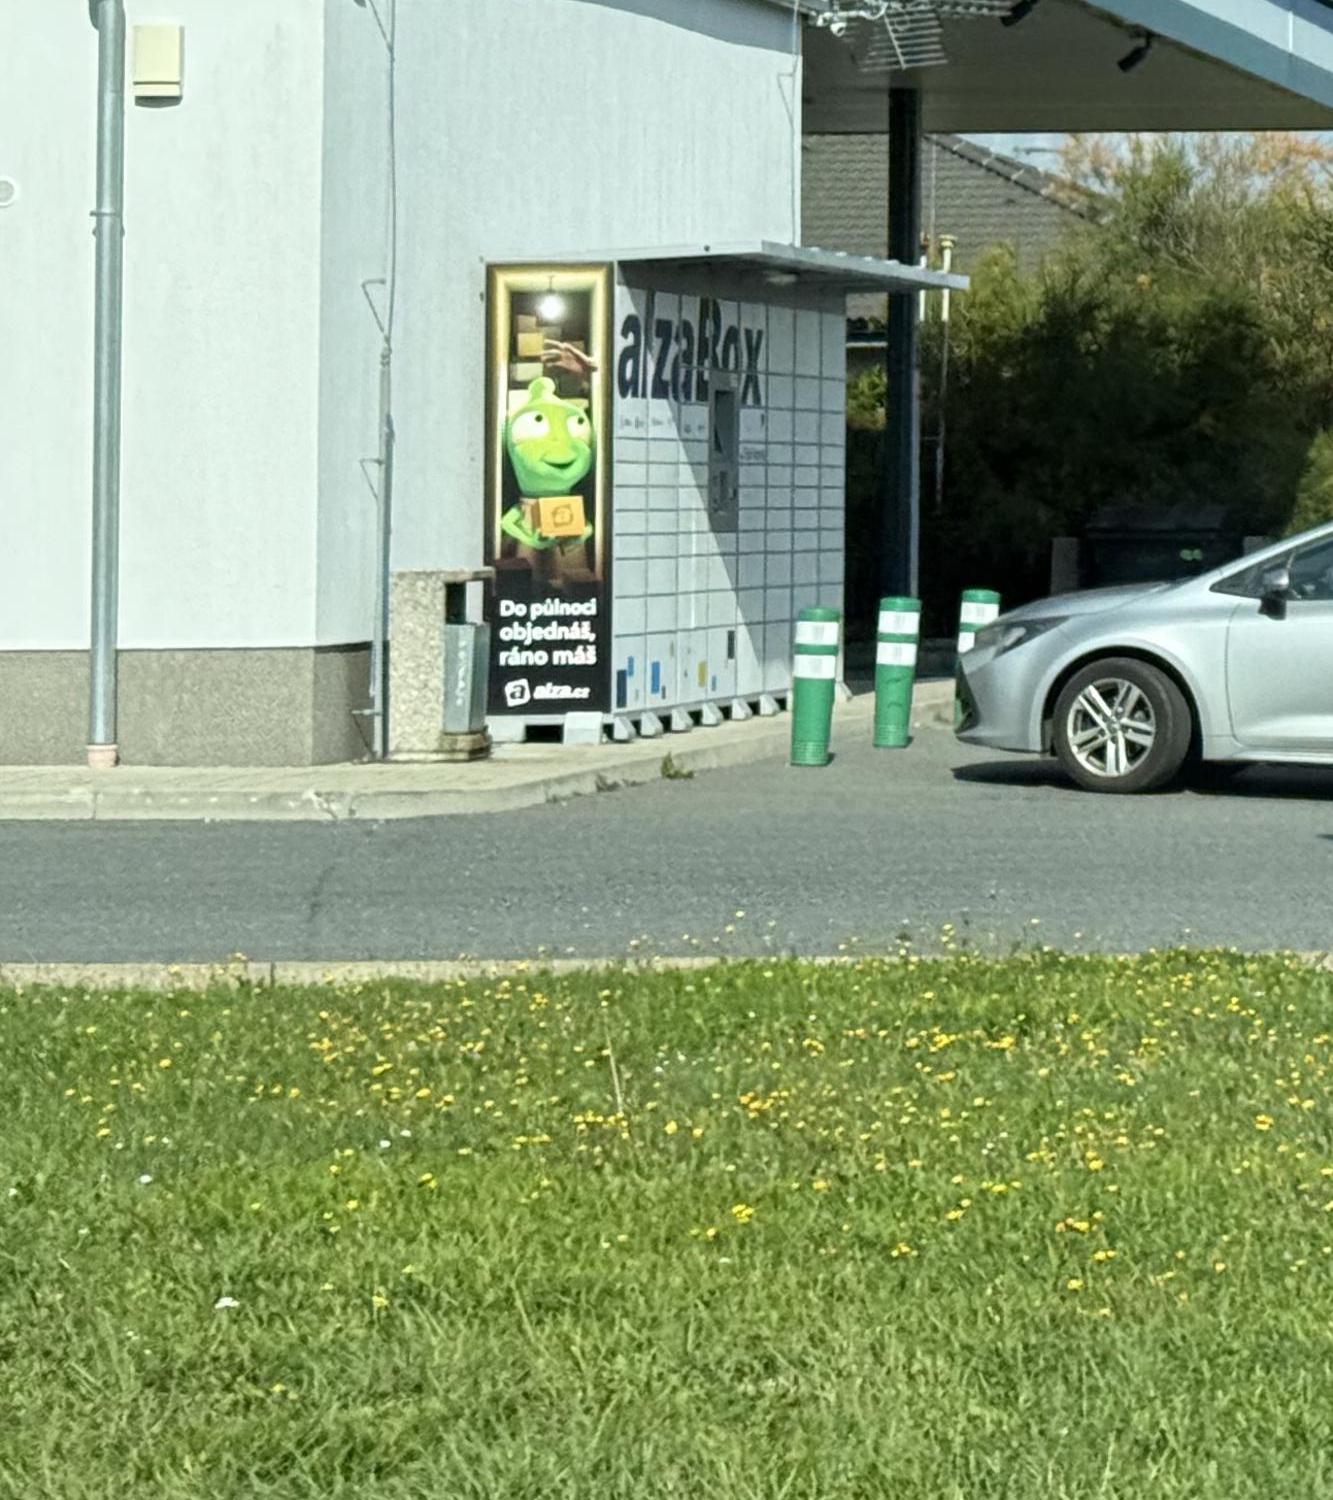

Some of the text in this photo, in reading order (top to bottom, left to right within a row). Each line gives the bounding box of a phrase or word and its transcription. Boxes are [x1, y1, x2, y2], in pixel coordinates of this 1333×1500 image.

[618, 290, 764, 406] alzaBox
[500, 598, 597, 621] Do půlnoci
[499, 621, 597, 645] objednáš,
[499, 645, 597, 666] ráno máš
